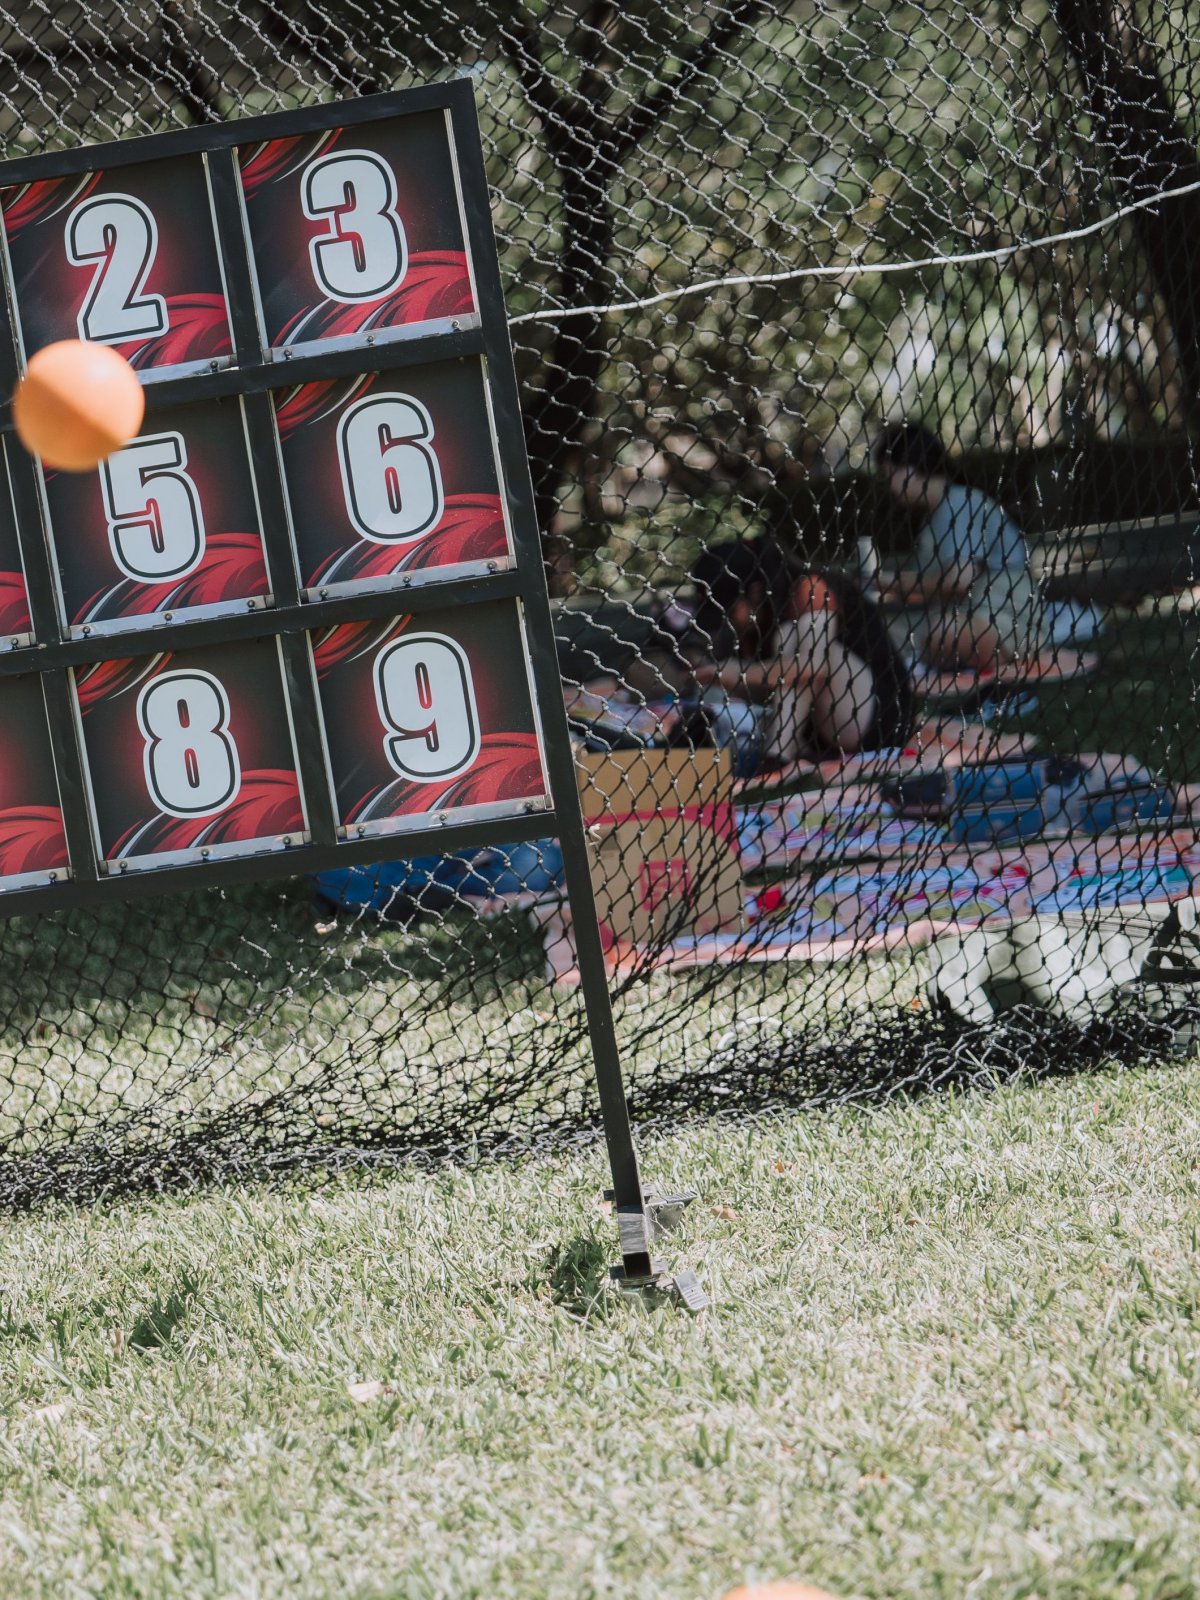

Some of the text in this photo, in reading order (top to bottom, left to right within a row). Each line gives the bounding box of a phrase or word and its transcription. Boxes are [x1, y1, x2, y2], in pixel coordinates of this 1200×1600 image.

[64, 193, 169, 342] 2
[300, 149, 408, 304] 3
[98, 431, 206, 584] 5
[336, 392, 444, 545] 6
[136, 669, 241, 818] 8
[373, 632, 481, 783] 9
